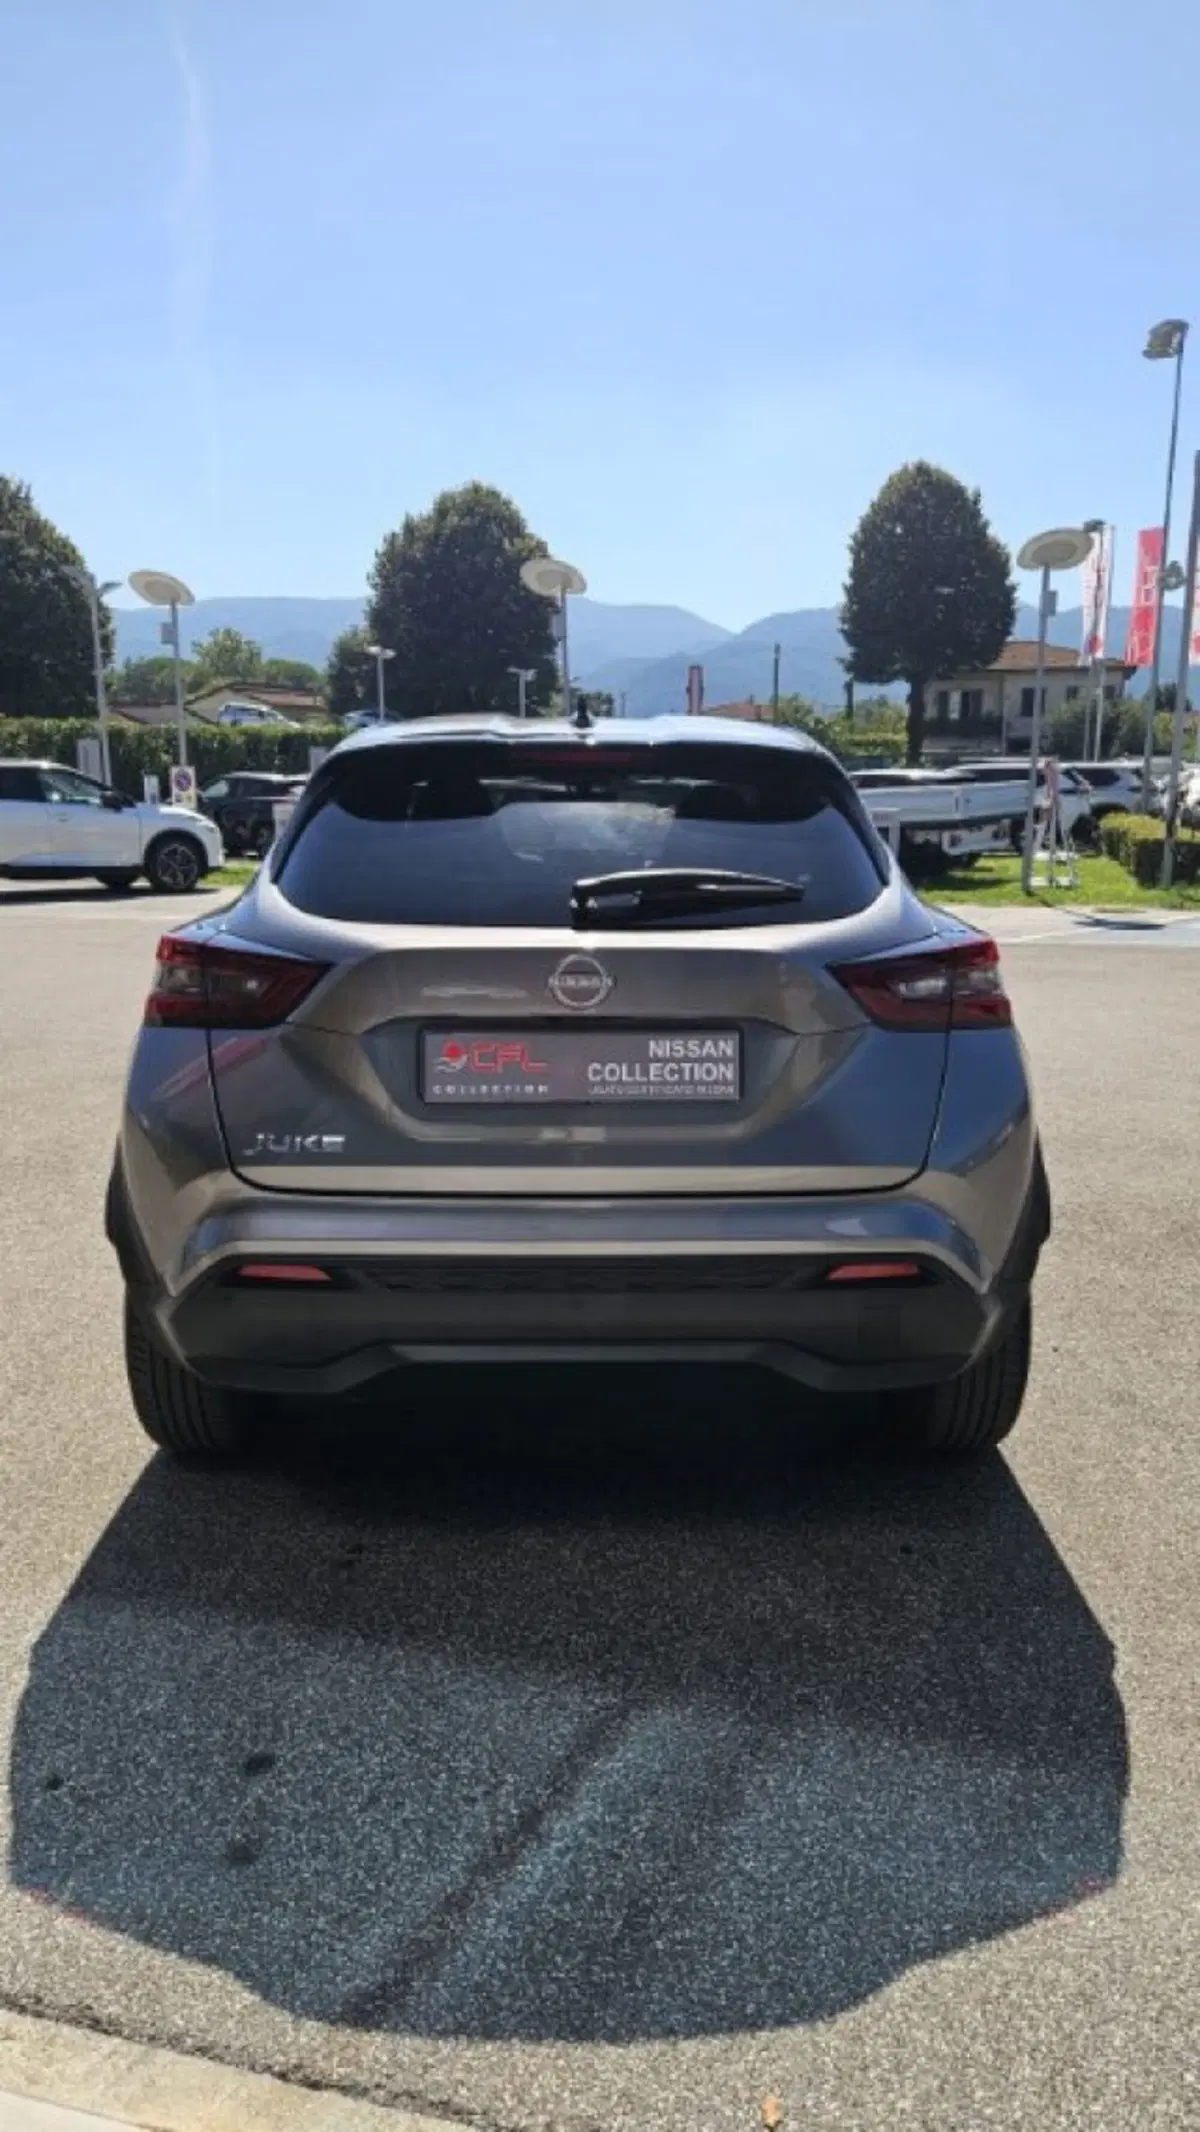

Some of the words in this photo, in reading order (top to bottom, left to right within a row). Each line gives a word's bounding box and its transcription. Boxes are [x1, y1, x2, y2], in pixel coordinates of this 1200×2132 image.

[649, 1038, 734, 1058] NISSAN
[587, 1062, 734, 1081] COLLECTION
[242, 1132, 345, 1155] JUKE
